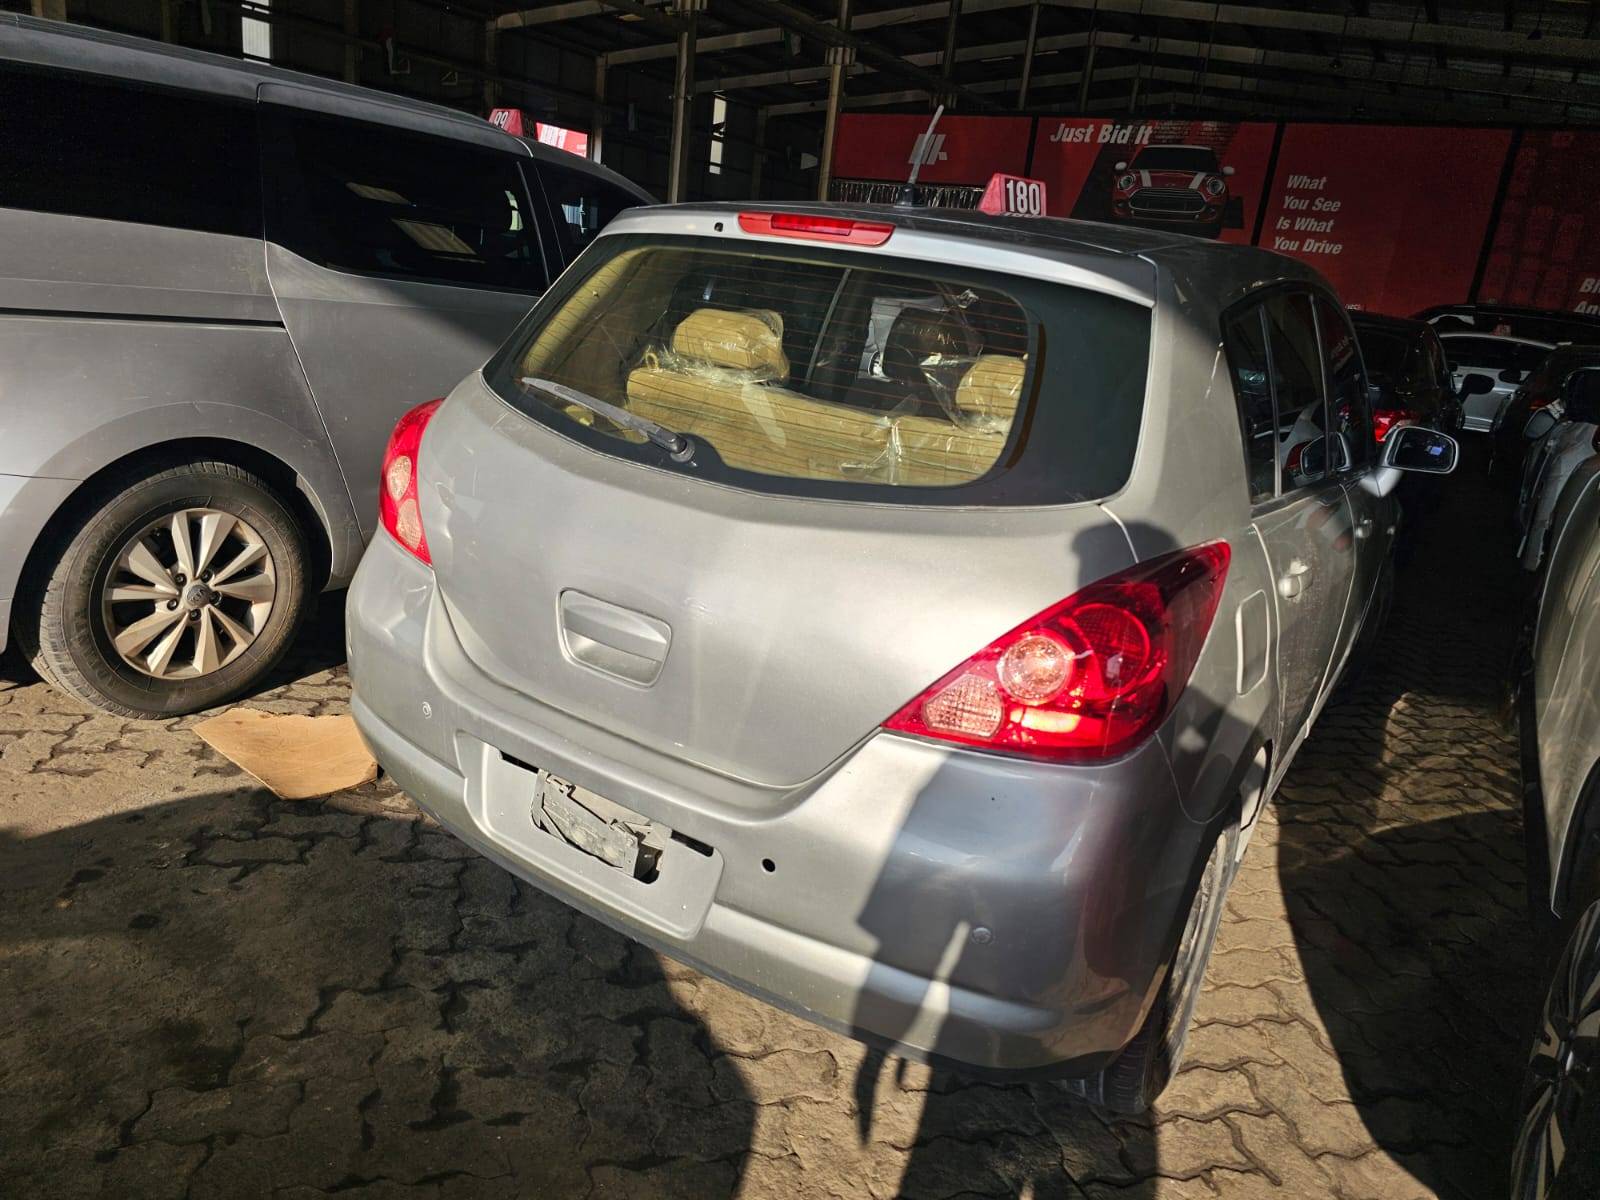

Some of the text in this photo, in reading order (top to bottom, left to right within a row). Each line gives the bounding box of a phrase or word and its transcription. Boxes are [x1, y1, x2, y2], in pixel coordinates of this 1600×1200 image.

[1049, 123, 1095, 143] Just
[1096, 124, 1134, 144] Bid
[1133, 125, 1153, 145] It
[1287, 175, 1327, 190] What
[1006, 179, 1040, 215] 180
[1283, 195, 1341, 212] You See
[1276, 216, 1334, 233] Is What
[1273, 236, 1343, 255] You Drive
